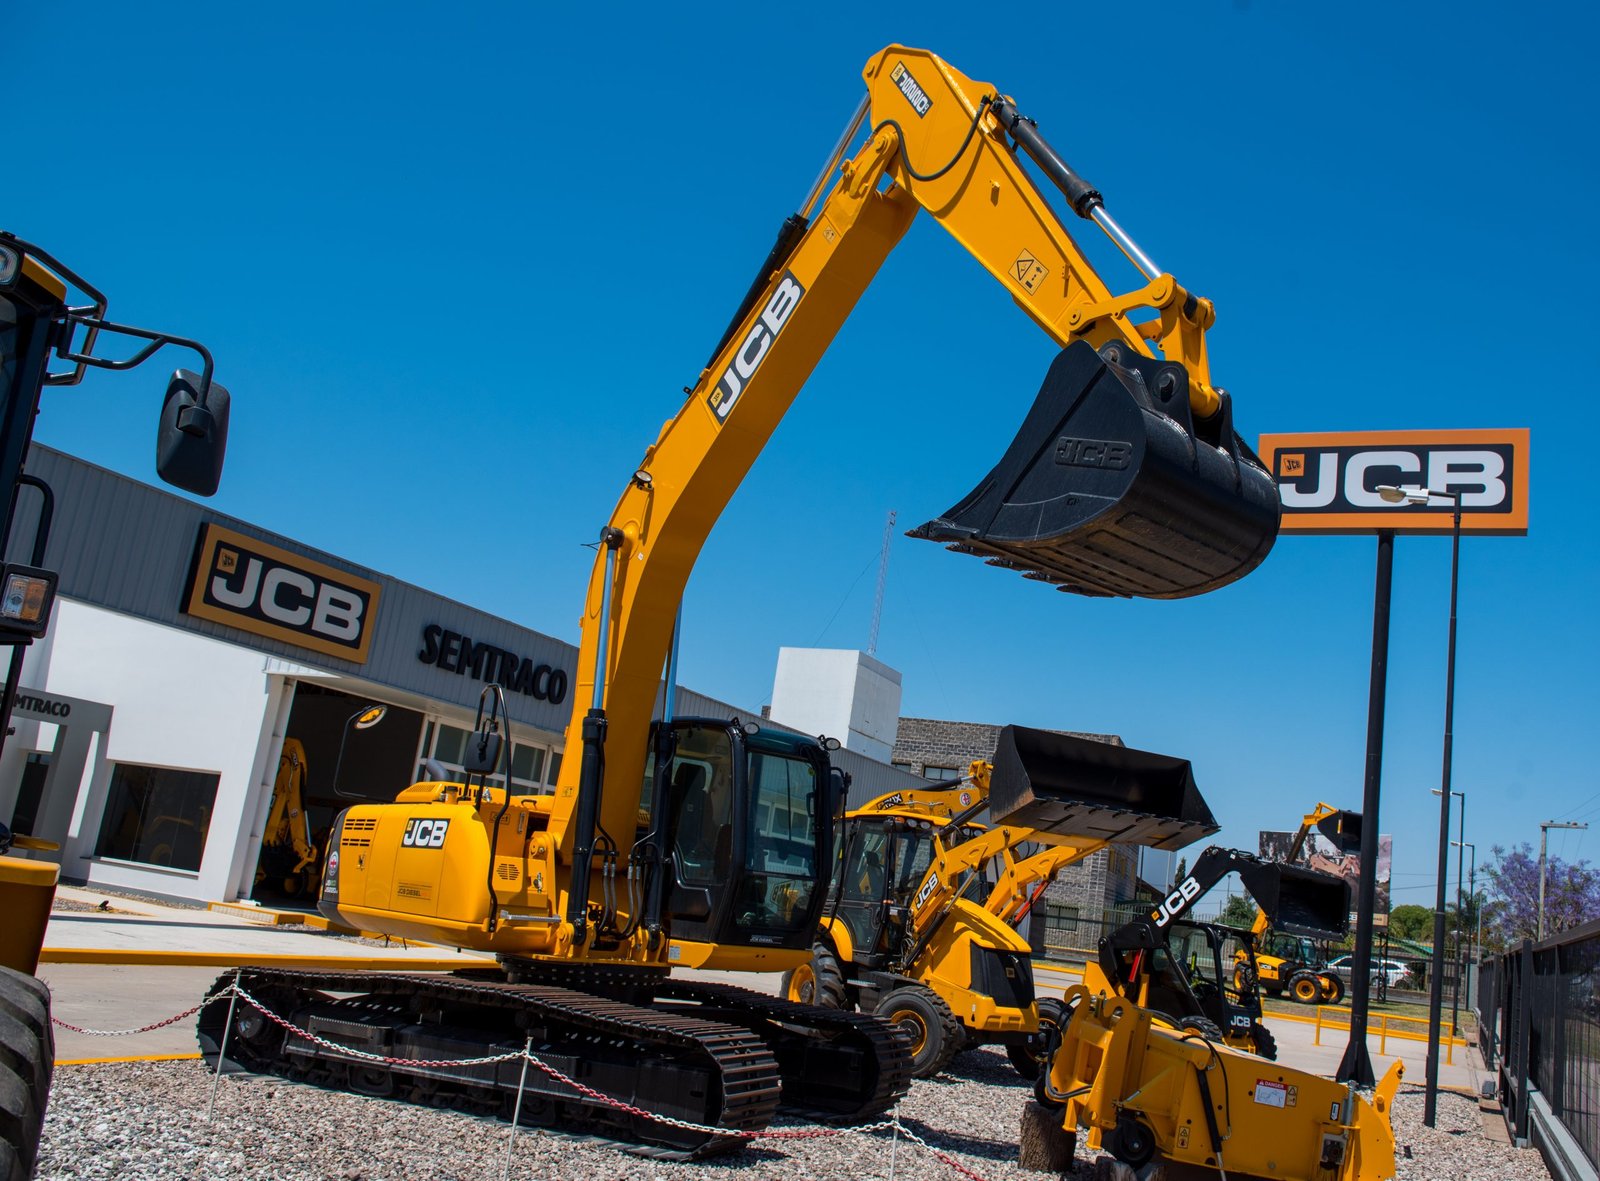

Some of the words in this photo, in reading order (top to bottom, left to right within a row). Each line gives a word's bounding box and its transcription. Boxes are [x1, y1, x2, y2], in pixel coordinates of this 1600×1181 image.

[717, 278, 801, 417] JCB
[1057, 439, 1131, 469] JCB
[1278, 450, 1506, 508] JCB
[211, 557, 363, 641] JCB
[418, 624, 568, 705] SEMTRACO
[0, 690, 71, 717] MTRACO
[403, 820, 449, 847] JCB
[917, 873, 938, 909] JCB
[1156, 876, 1201, 927] JCB
[1230, 1015, 1251, 1028] JCB
[1265, 1081, 1284, 1090] DANGER
